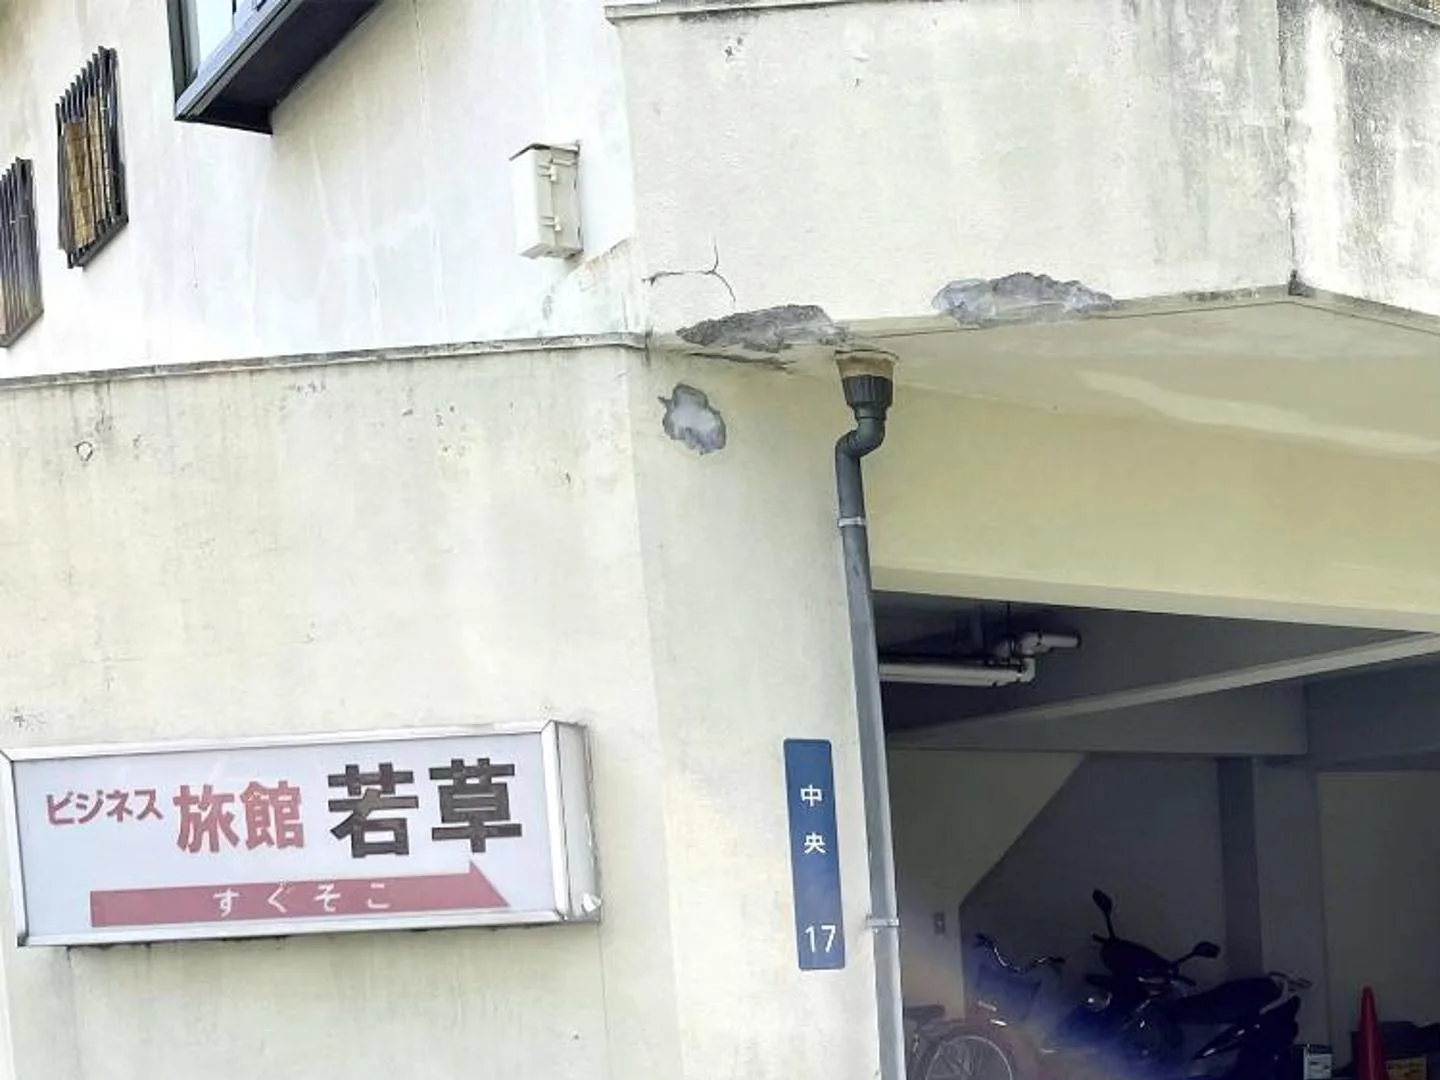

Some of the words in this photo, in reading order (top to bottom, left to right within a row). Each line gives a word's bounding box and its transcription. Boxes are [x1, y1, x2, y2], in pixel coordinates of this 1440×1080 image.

[46, 788, 163, 825] ビジネス
[172, 780, 305, 853] 旅館
[327, 757, 523, 859] 若草
[800, 784, 826, 855] 中央
[212, 880, 391, 918] すぐそこ
[804, 924, 837, 953] 17
